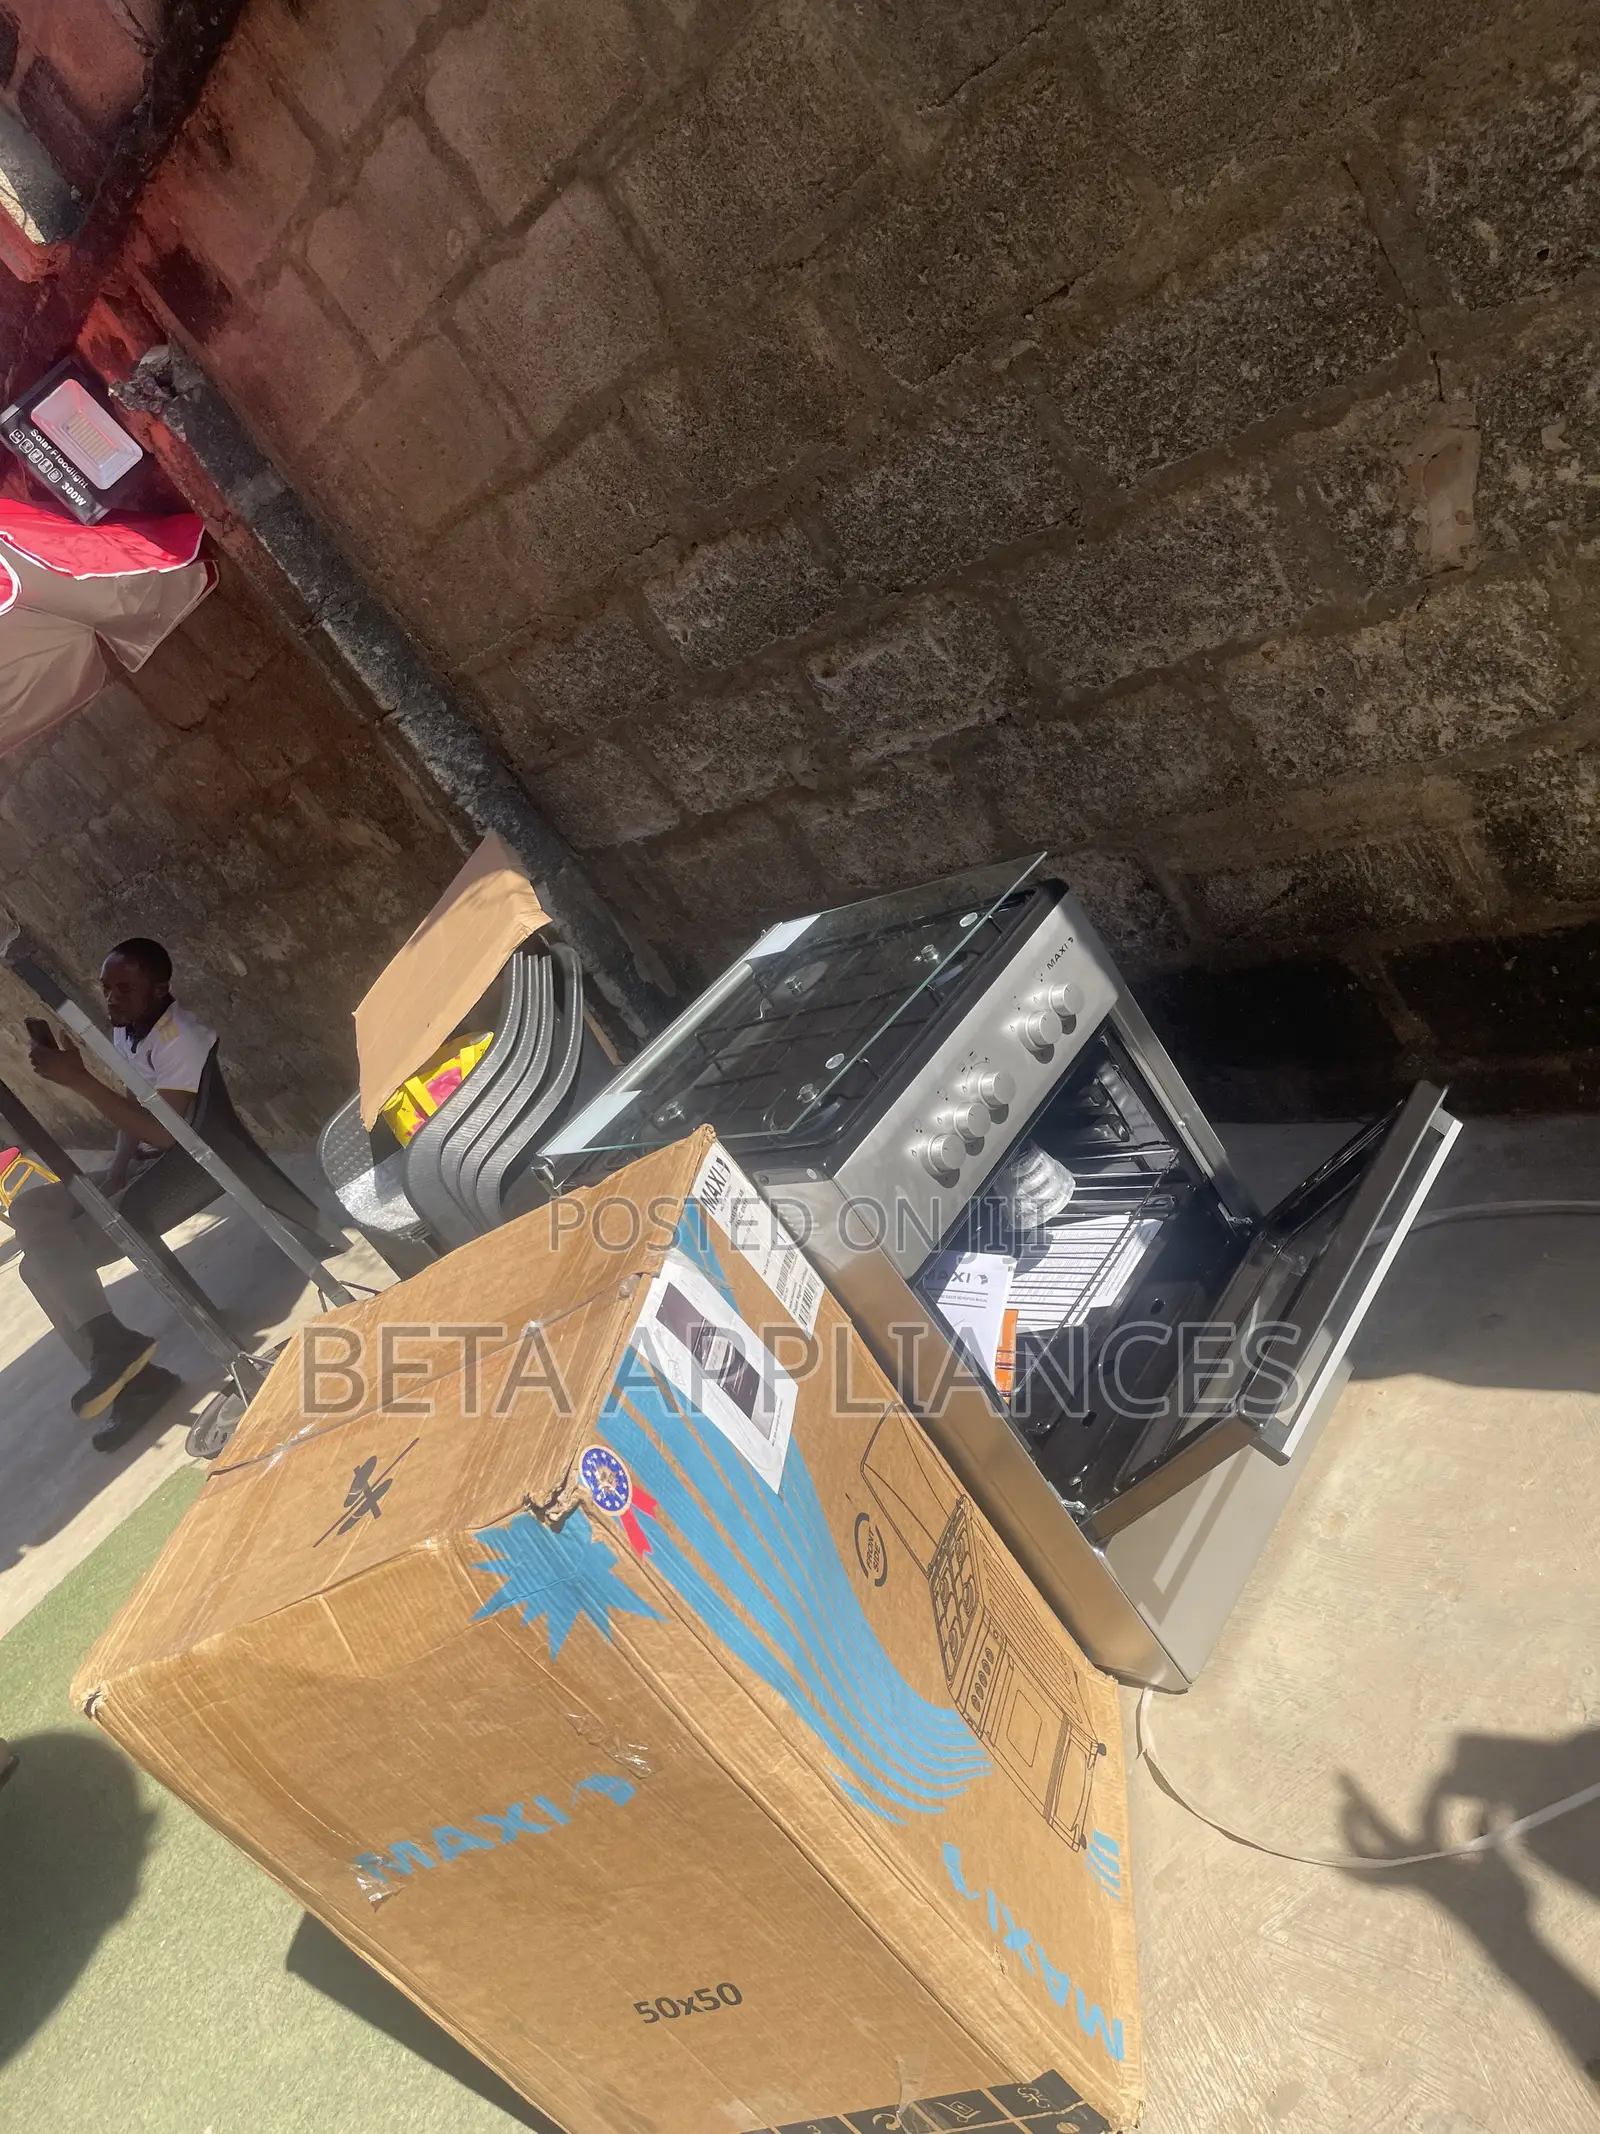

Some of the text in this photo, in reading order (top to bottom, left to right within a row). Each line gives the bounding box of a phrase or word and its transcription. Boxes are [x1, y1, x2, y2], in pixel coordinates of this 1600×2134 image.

[30, 429, 89, 489] Solar Floodlight
[61, 482, 87, 506] 300W
[1046, 943, 1069, 971] MAXI
[699, 1165, 728, 1215] MAXI
[866, 1526, 875, 1570] FRONT
[873, 1541, 881, 1573] SIDE
[353, 1794, 573, 1883] MAXI
[986, 1886, 1125, 2061] MAXI
[633, 1982, 743, 2024] 50x50
